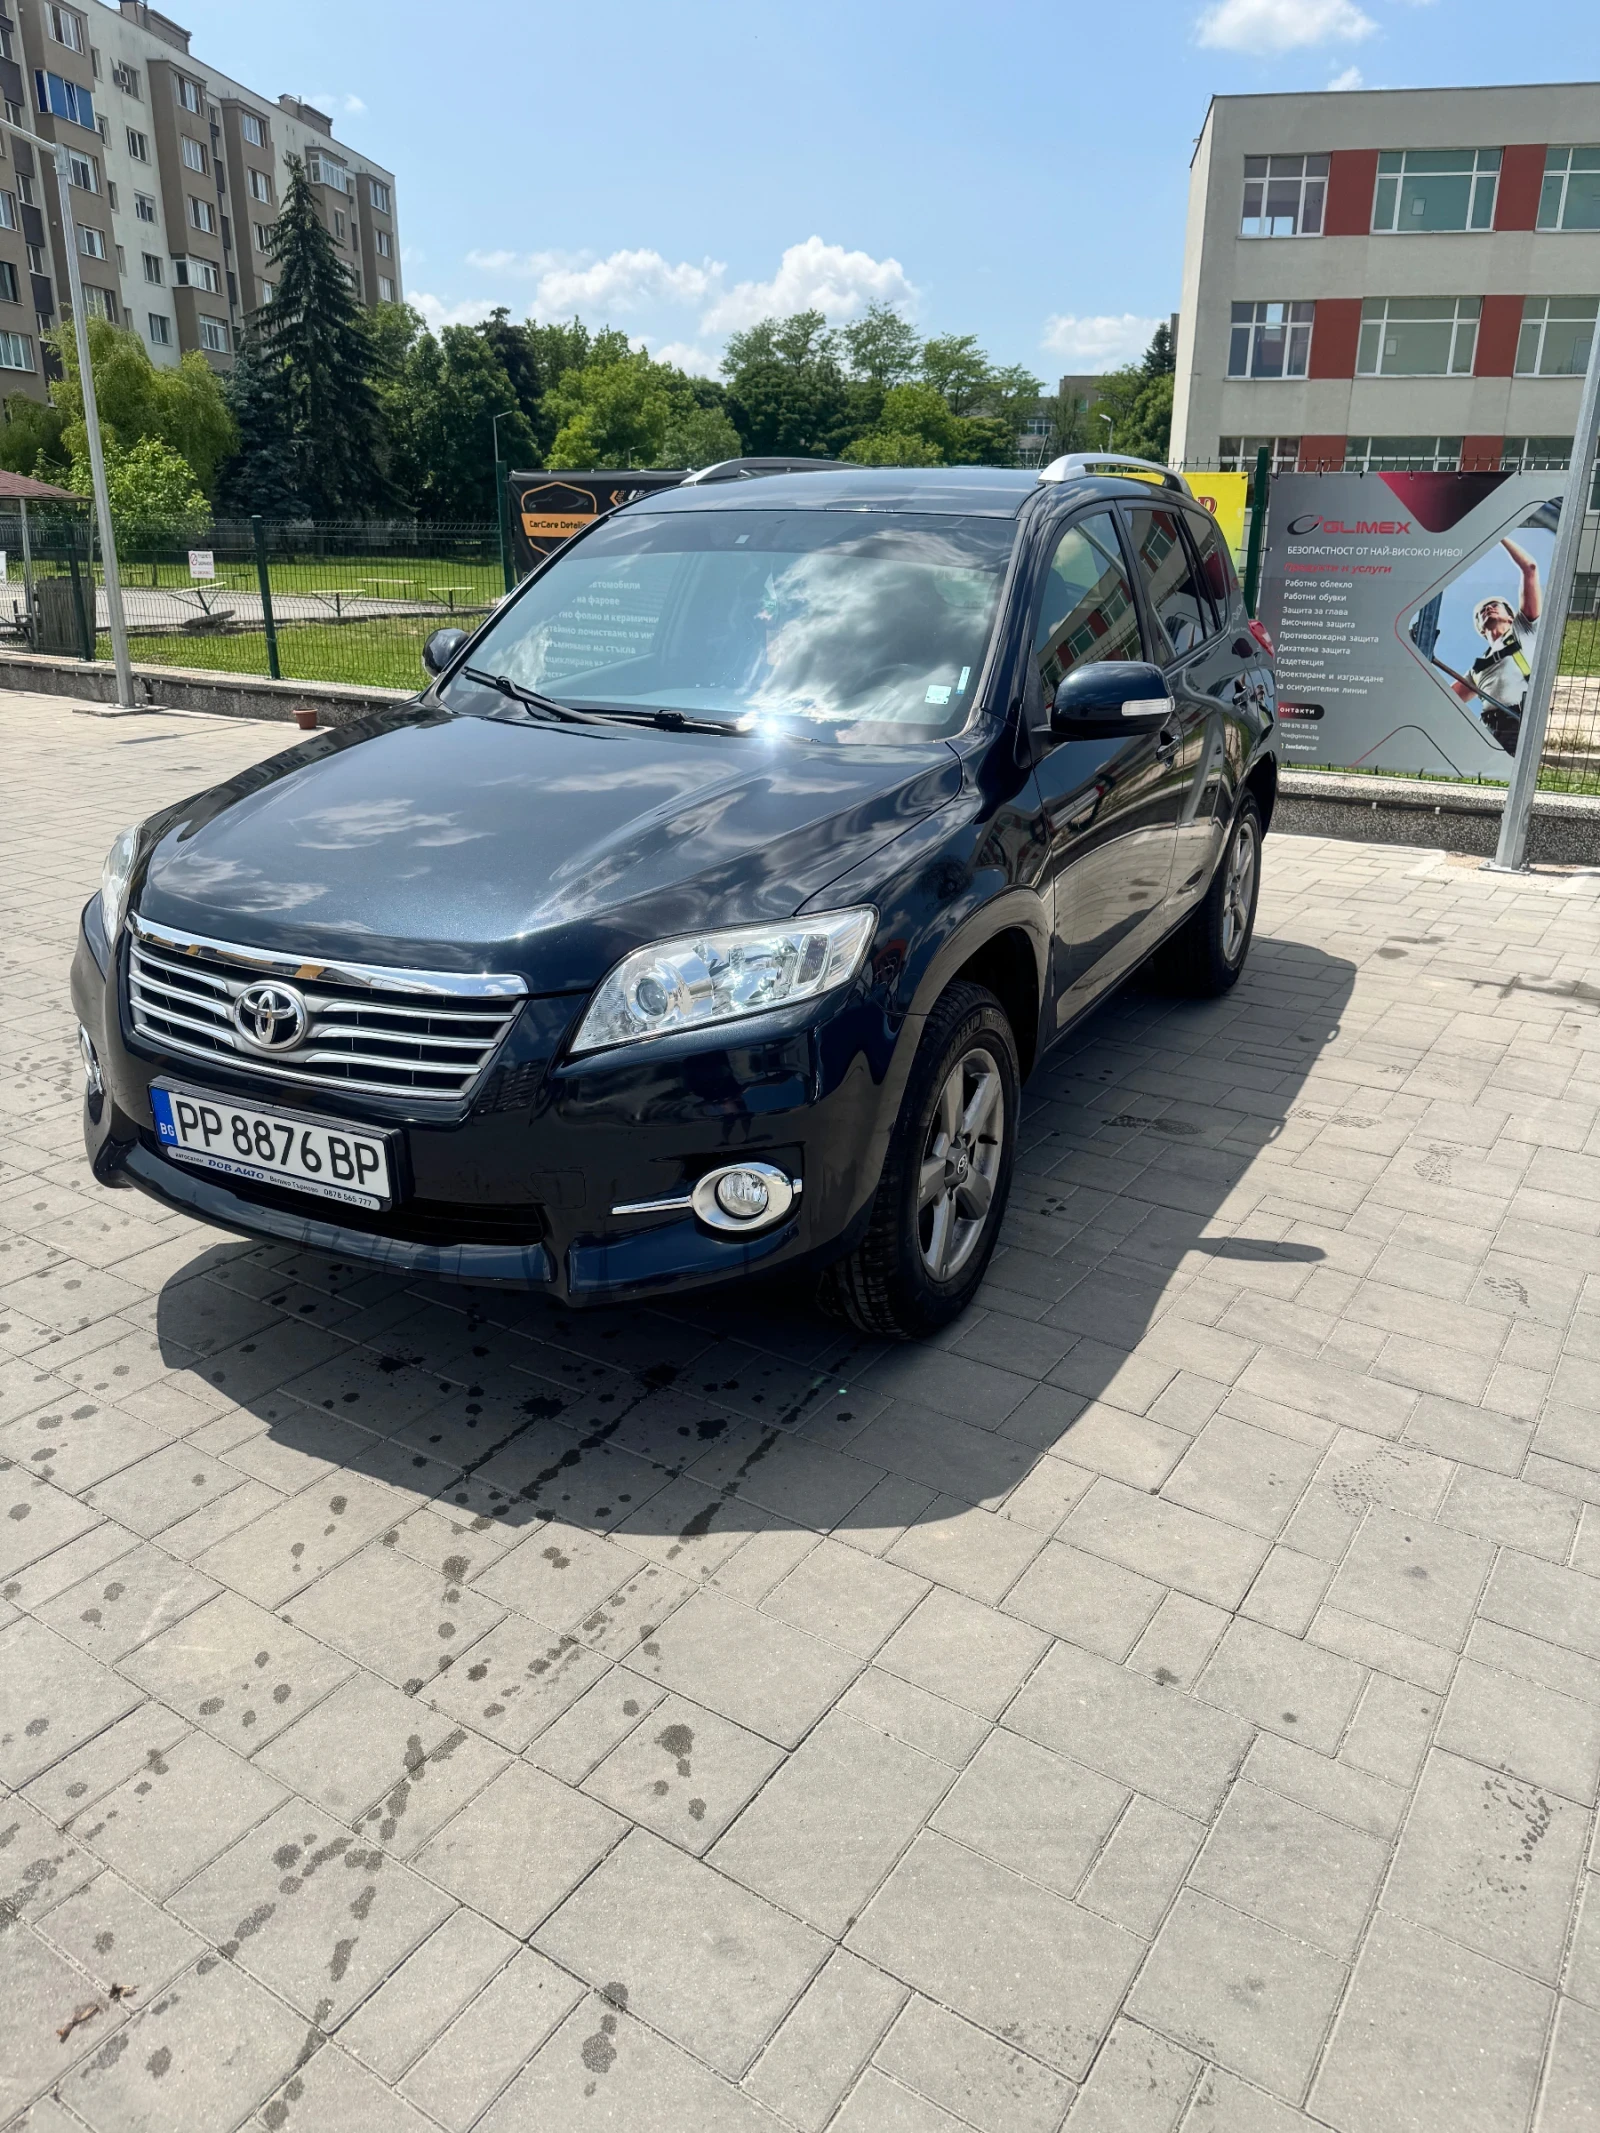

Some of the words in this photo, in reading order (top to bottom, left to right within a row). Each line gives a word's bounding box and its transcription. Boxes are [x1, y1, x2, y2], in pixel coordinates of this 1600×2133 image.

[529, 520, 559, 529] CarCare
[1322, 520, 1411, 534] GLIMEX
[1287, 546, 1354, 556] БЕЗОПАСТНОСТ
[1356, 546, 1369, 556] ОТ
[1370, 545, 1431, 557] НАЙ-ВИСОКО
[1432, 548, 1463, 557] НИВО!
[1351, 565, 1392, 575] услуги
[1284, 579, 1317, 588] Работно
[1319, 580, 1353, 589] облекло
[587, 595, 620, 606] фарове
[1283, 592, 1316, 601] Работни
[1318, 593, 1347, 603] обувки
[574, 610, 602, 621] фолио
[1282, 606, 1313, 615] Защита
[1313, 607, 1324, 615] за
[1325, 608, 1349, 616] глава
[1281, 618, 1324, 627] Височинна
[1325, 621, 1356, 629] защита
[577, 627, 627, 638] почистване
[1279, 631, 1347, 642] Противопожарна
[1348, 635, 1380, 644] защита
[605, 645, 636, 655] стъкла
[1277, 644, 1319, 653] Дихателна
[1321, 647, 1351, 655] защита
[1276, 656, 1325, 667] Газдетекция
[1275, 669, 1326, 680] Проектиране
[1337, 675, 1384, 683] изграждане
[1286, 682, 1339, 693] осигурителни
[1341, 687, 1368, 695] линии
[1278, 705, 1315, 715] онтакти
[159, 1122, 175, 1137] BG
[230, 1114, 322, 1174] 8876
[207, 1159, 232, 1172] DOB
[234, 1166, 265, 1180] AUTO
[269, 1175, 292, 1187] Велико
[323, 1188, 342, 1199] 0878
[343, 1194, 357, 1203] 565
[358, 1197, 372, 1207] 777
